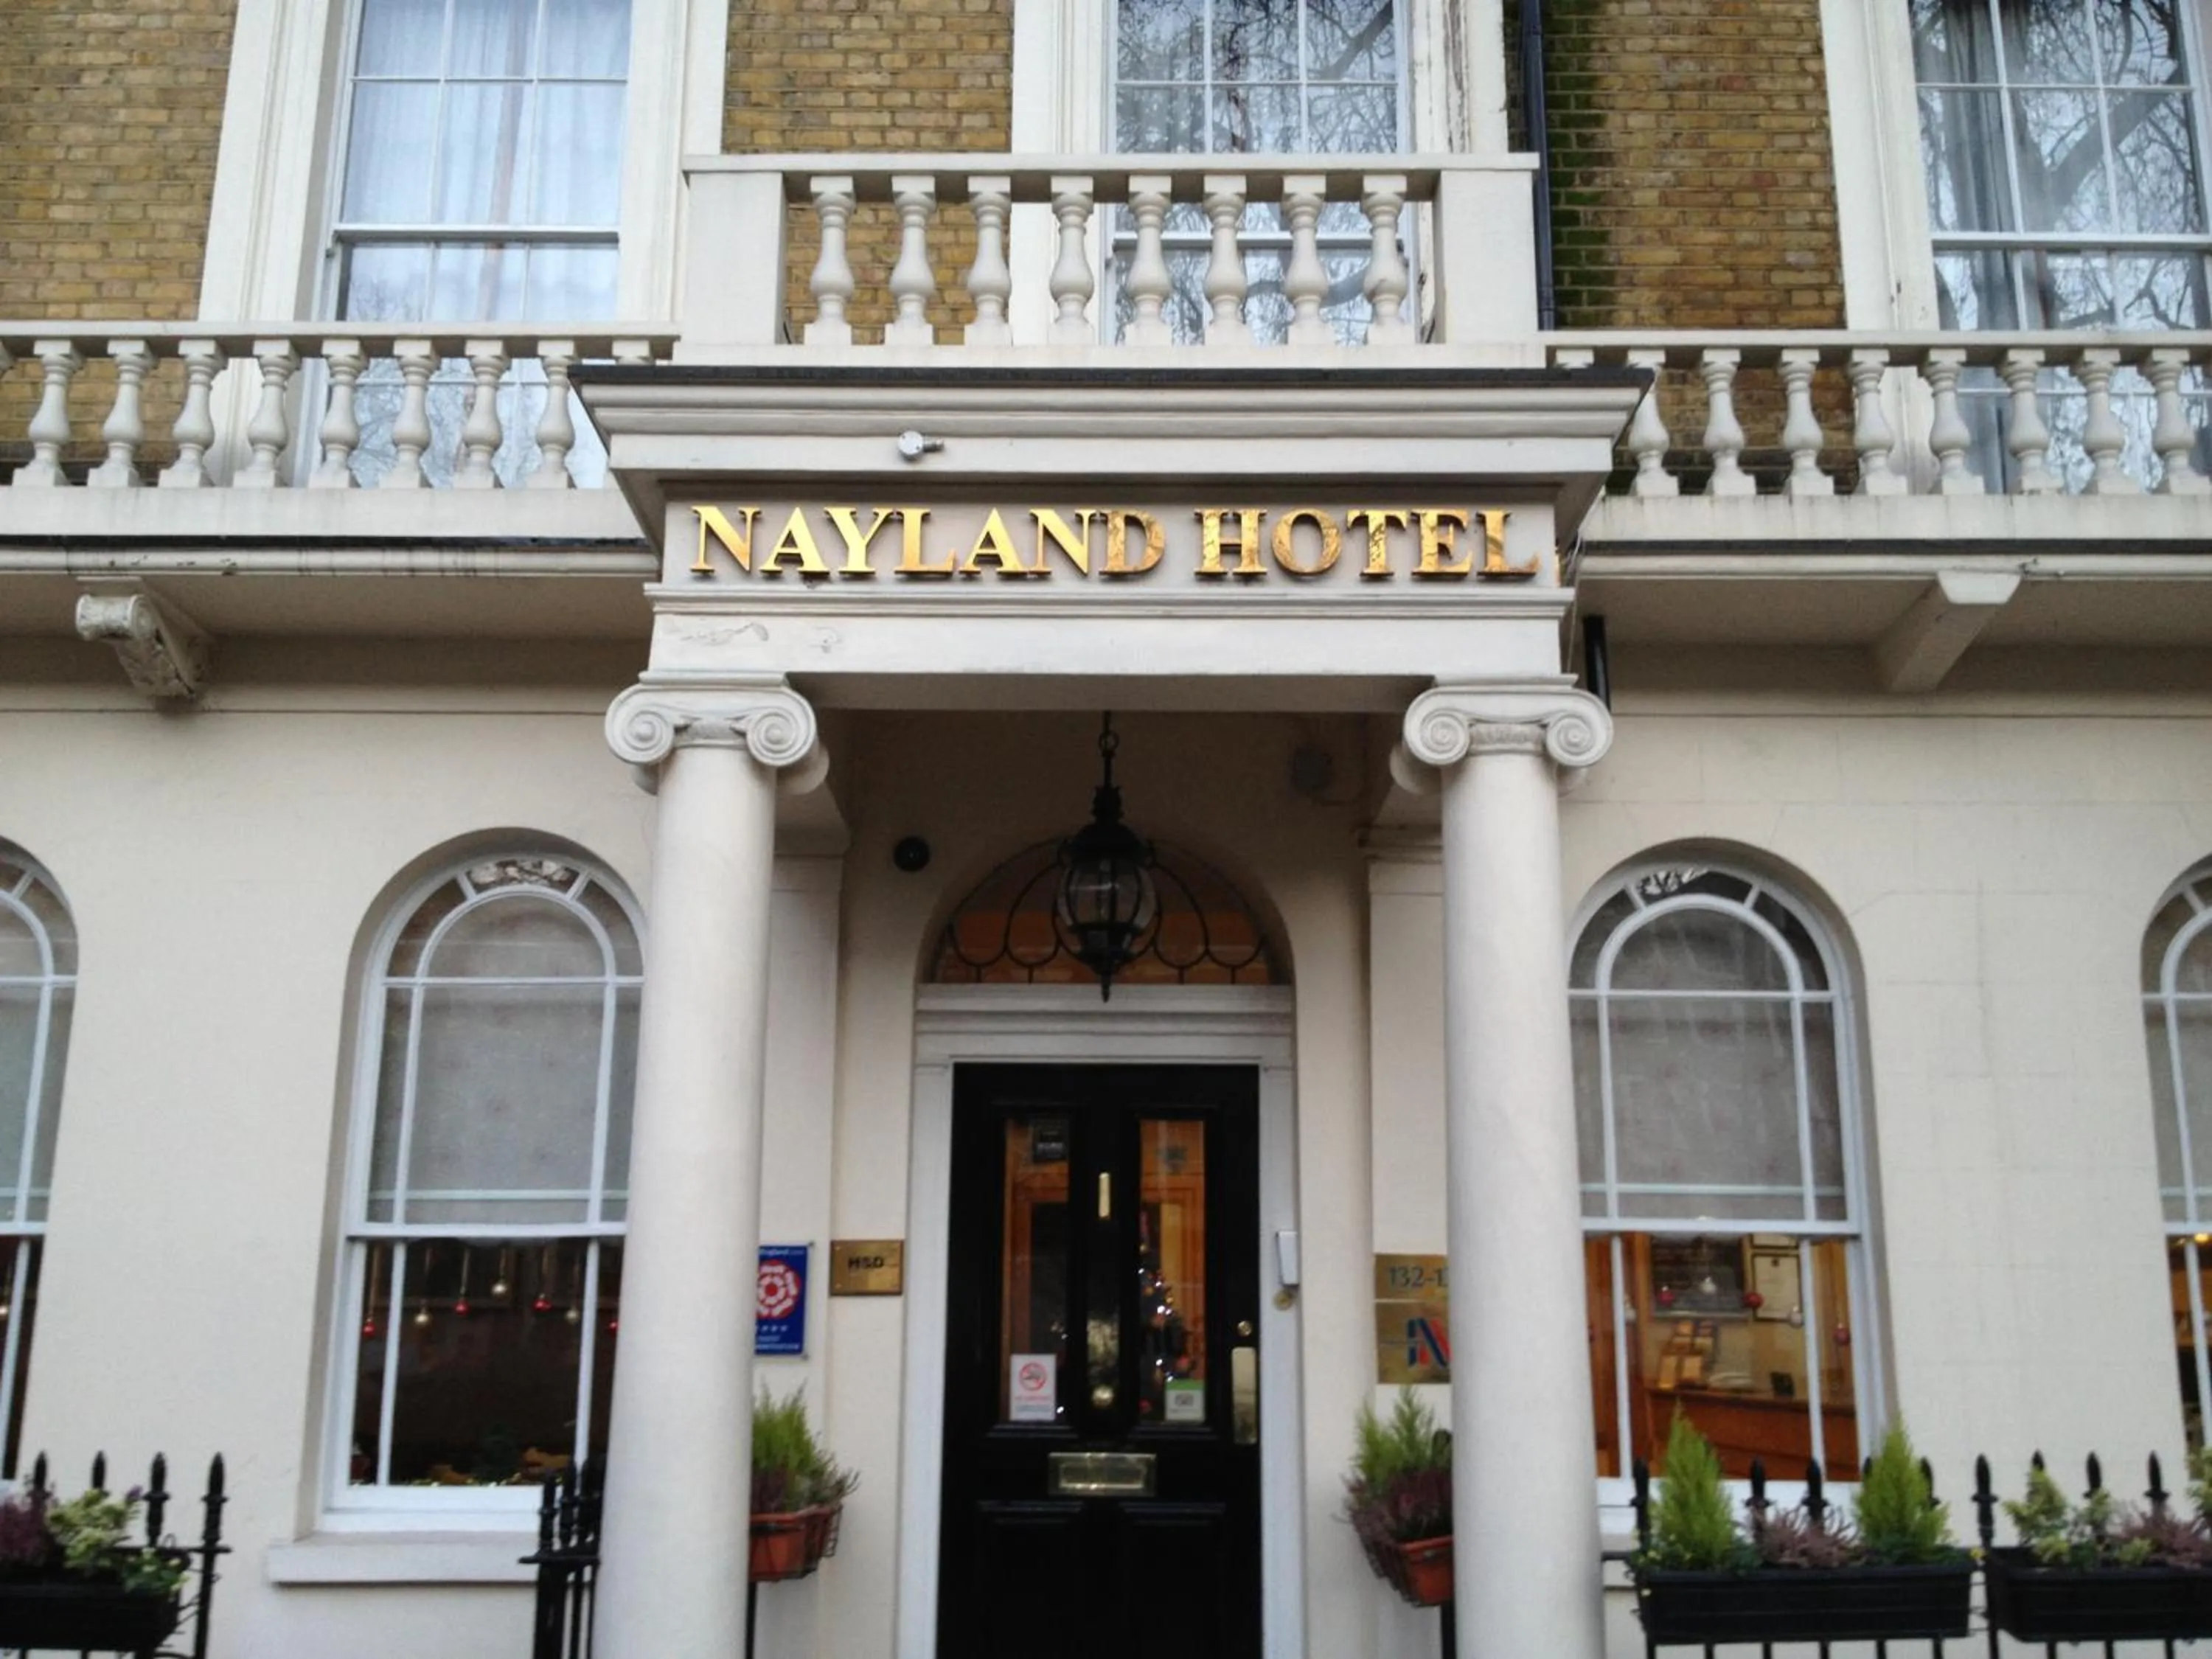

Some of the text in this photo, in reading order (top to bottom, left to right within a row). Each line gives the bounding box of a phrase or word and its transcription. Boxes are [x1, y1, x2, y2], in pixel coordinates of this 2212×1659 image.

[689, 506, 1541, 577] NAYLAND HOTEL
[1389, 1266, 1449, 1287] 132-1
